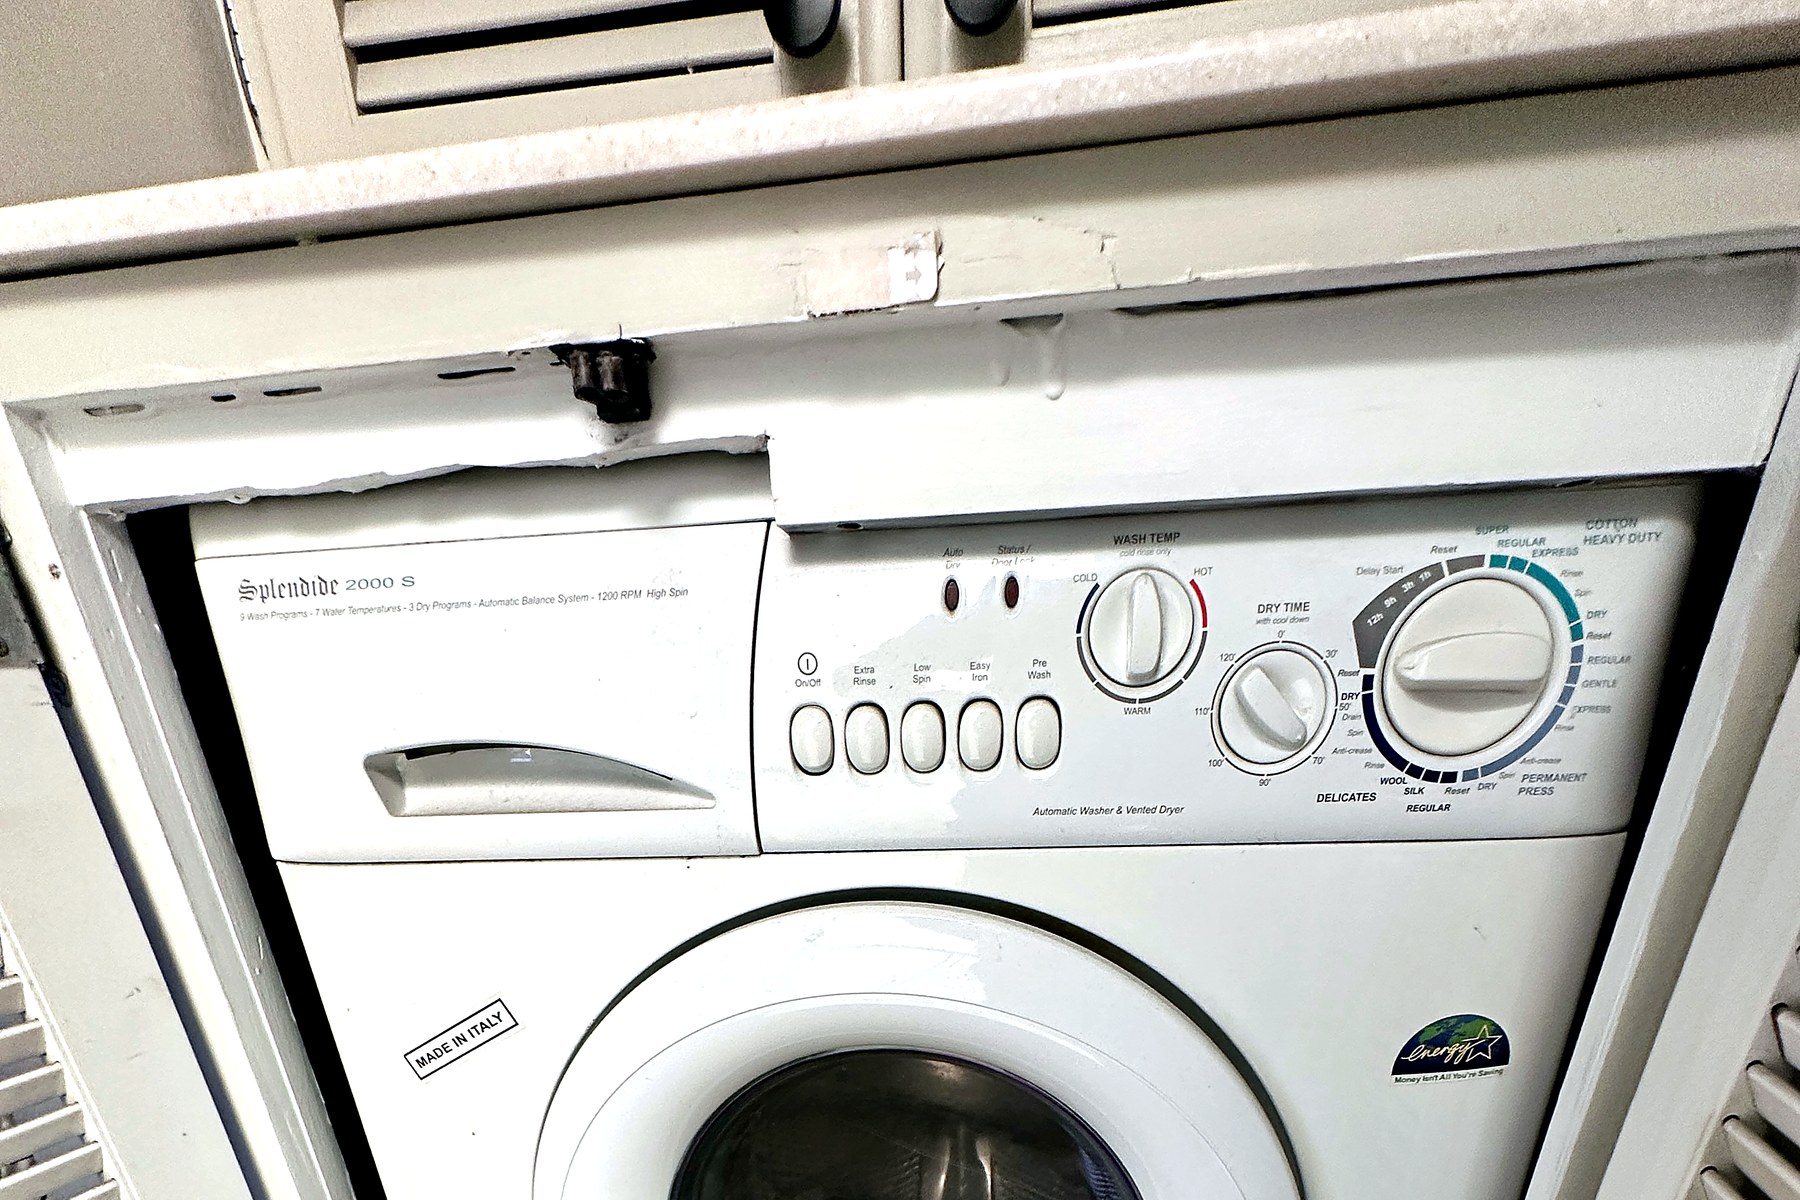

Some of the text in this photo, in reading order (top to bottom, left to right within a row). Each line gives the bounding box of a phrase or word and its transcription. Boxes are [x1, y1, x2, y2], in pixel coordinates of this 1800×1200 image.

[1585, 518, 1638, 530] COTTON
[1475, 525, 1510, 535] SUPER
[1113, 532, 1181, 545] WASH TEMP
[1497, 537, 1546, 548] REGULAR
[1583, 532, 1662, 545] HEAVY DUTY
[942, 547, 964, 557] Auto
[1156, 548, 1172, 556] only
[1430, 545, 1457, 554] Reset
[1531, 547, 1579, 558] EXPRESS
[1193, 567, 1214, 576] HOT
[1356, 565, 1404, 576] Delay Start
[1073, 573, 1098, 582] COLD
[239, 575, 415, 603] Splendide 2000 S
[247, 612, 268, 620] Wash
[270, 610, 308, 621] Programs
[322, 608, 346, 617] Water
[348, 605, 401, 615] Temperatures
[409, 603, 414, 611] 3
[415, 602, 430, 612] Dry
[432, 600, 471, 612] Programs
[478, 598, 520, 608] Automatic
[522, 596, 555, 605] Balance
[557, 593, 589, 605] System
[597, 591, 618, 601] 1200
[620, 590, 642, 600] RPM
[646, 589, 667, 600] High
[669, 587, 688, 598] Spin
[1367, 612, 1384, 626] 12h
[1384, 596, 1397, 608] 9h
[1401, 580, 1414, 593] 3h
[1257, 602, 1310, 614] DRY TIME
[1586, 610, 1608, 619] DRY
[1256, 616, 1310, 625] with cool down
[1586, 631, 1612, 640] Reset
[1032, 659, 1047, 668] Pre
[1587, 655, 1632, 665] REGULAR
[854, 666, 875, 675] Extra
[913, 663, 931, 672] Low
[970, 661, 991, 672] Easy
[972, 673, 988, 682] Iron
[1027, 670, 1051, 680] Wash
[1338, 669, 1360, 677] Reset
[795, 678, 821, 688] On/Off
[853, 677, 876, 686] Rinse
[912, 674, 931, 684] Spin
[1582, 680, 1617, 689] GENTLE
[1341, 693, 1360, 701] DRY
[1124, 707, 1151, 715] WARM
[1347, 729, 1364, 737] Spin
[1331, 747, 1372, 755] Anti-crease
[1380, 777, 1408, 785] WOOL
[1521, 772, 1588, 783] PERMANENT
[1403, 787, 1425, 795] SILK
[1444, 786, 1470, 795] Reset
[1478, 782, 1497, 791] DRY
[1517, 786, 1555, 796] PRESS
[1316, 792, 1377, 803] DELICATES
[1033, 805, 1185, 816] Automatic Washer & Vented Dryer
[1406, 804, 1451, 813] REGULAR
[415, 1011, 503, 1069] MADE IN ITALY
[1394, 1076, 1421, 1084] Money
[1453, 1072, 1475, 1080] You're
[1478, 1069, 1504, 1077] Saving
